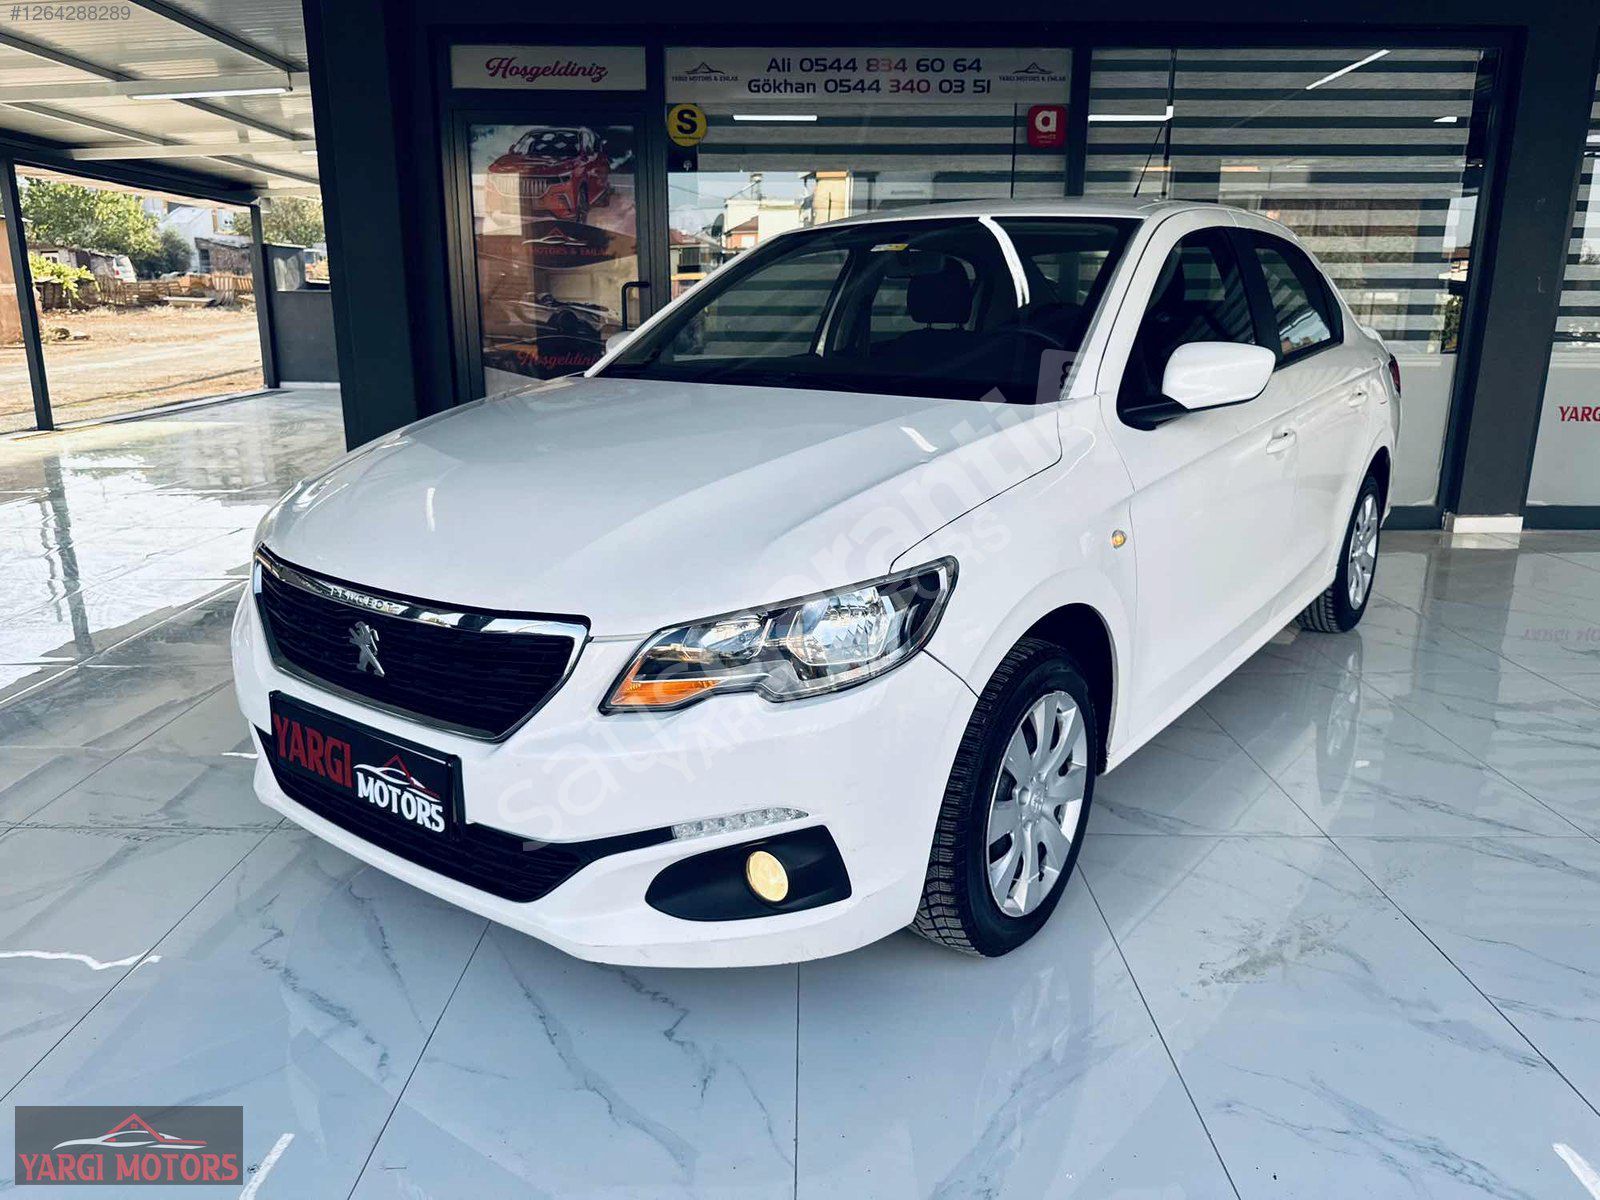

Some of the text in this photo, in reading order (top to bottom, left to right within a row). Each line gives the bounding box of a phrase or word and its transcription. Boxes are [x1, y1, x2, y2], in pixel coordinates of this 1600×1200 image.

[767, 57, 982, 73] Ali 0544 834 60 64
[747, 78, 817, 94] Gökhan
[824, 78, 881, 94] 0544
[889, 78, 931, 94] 340
[938, 78, 966, 94] 03
[677, 109, 698, 135] S
[273, 713, 352, 787] YARGI
[356, 771, 446, 833] MOTORS
